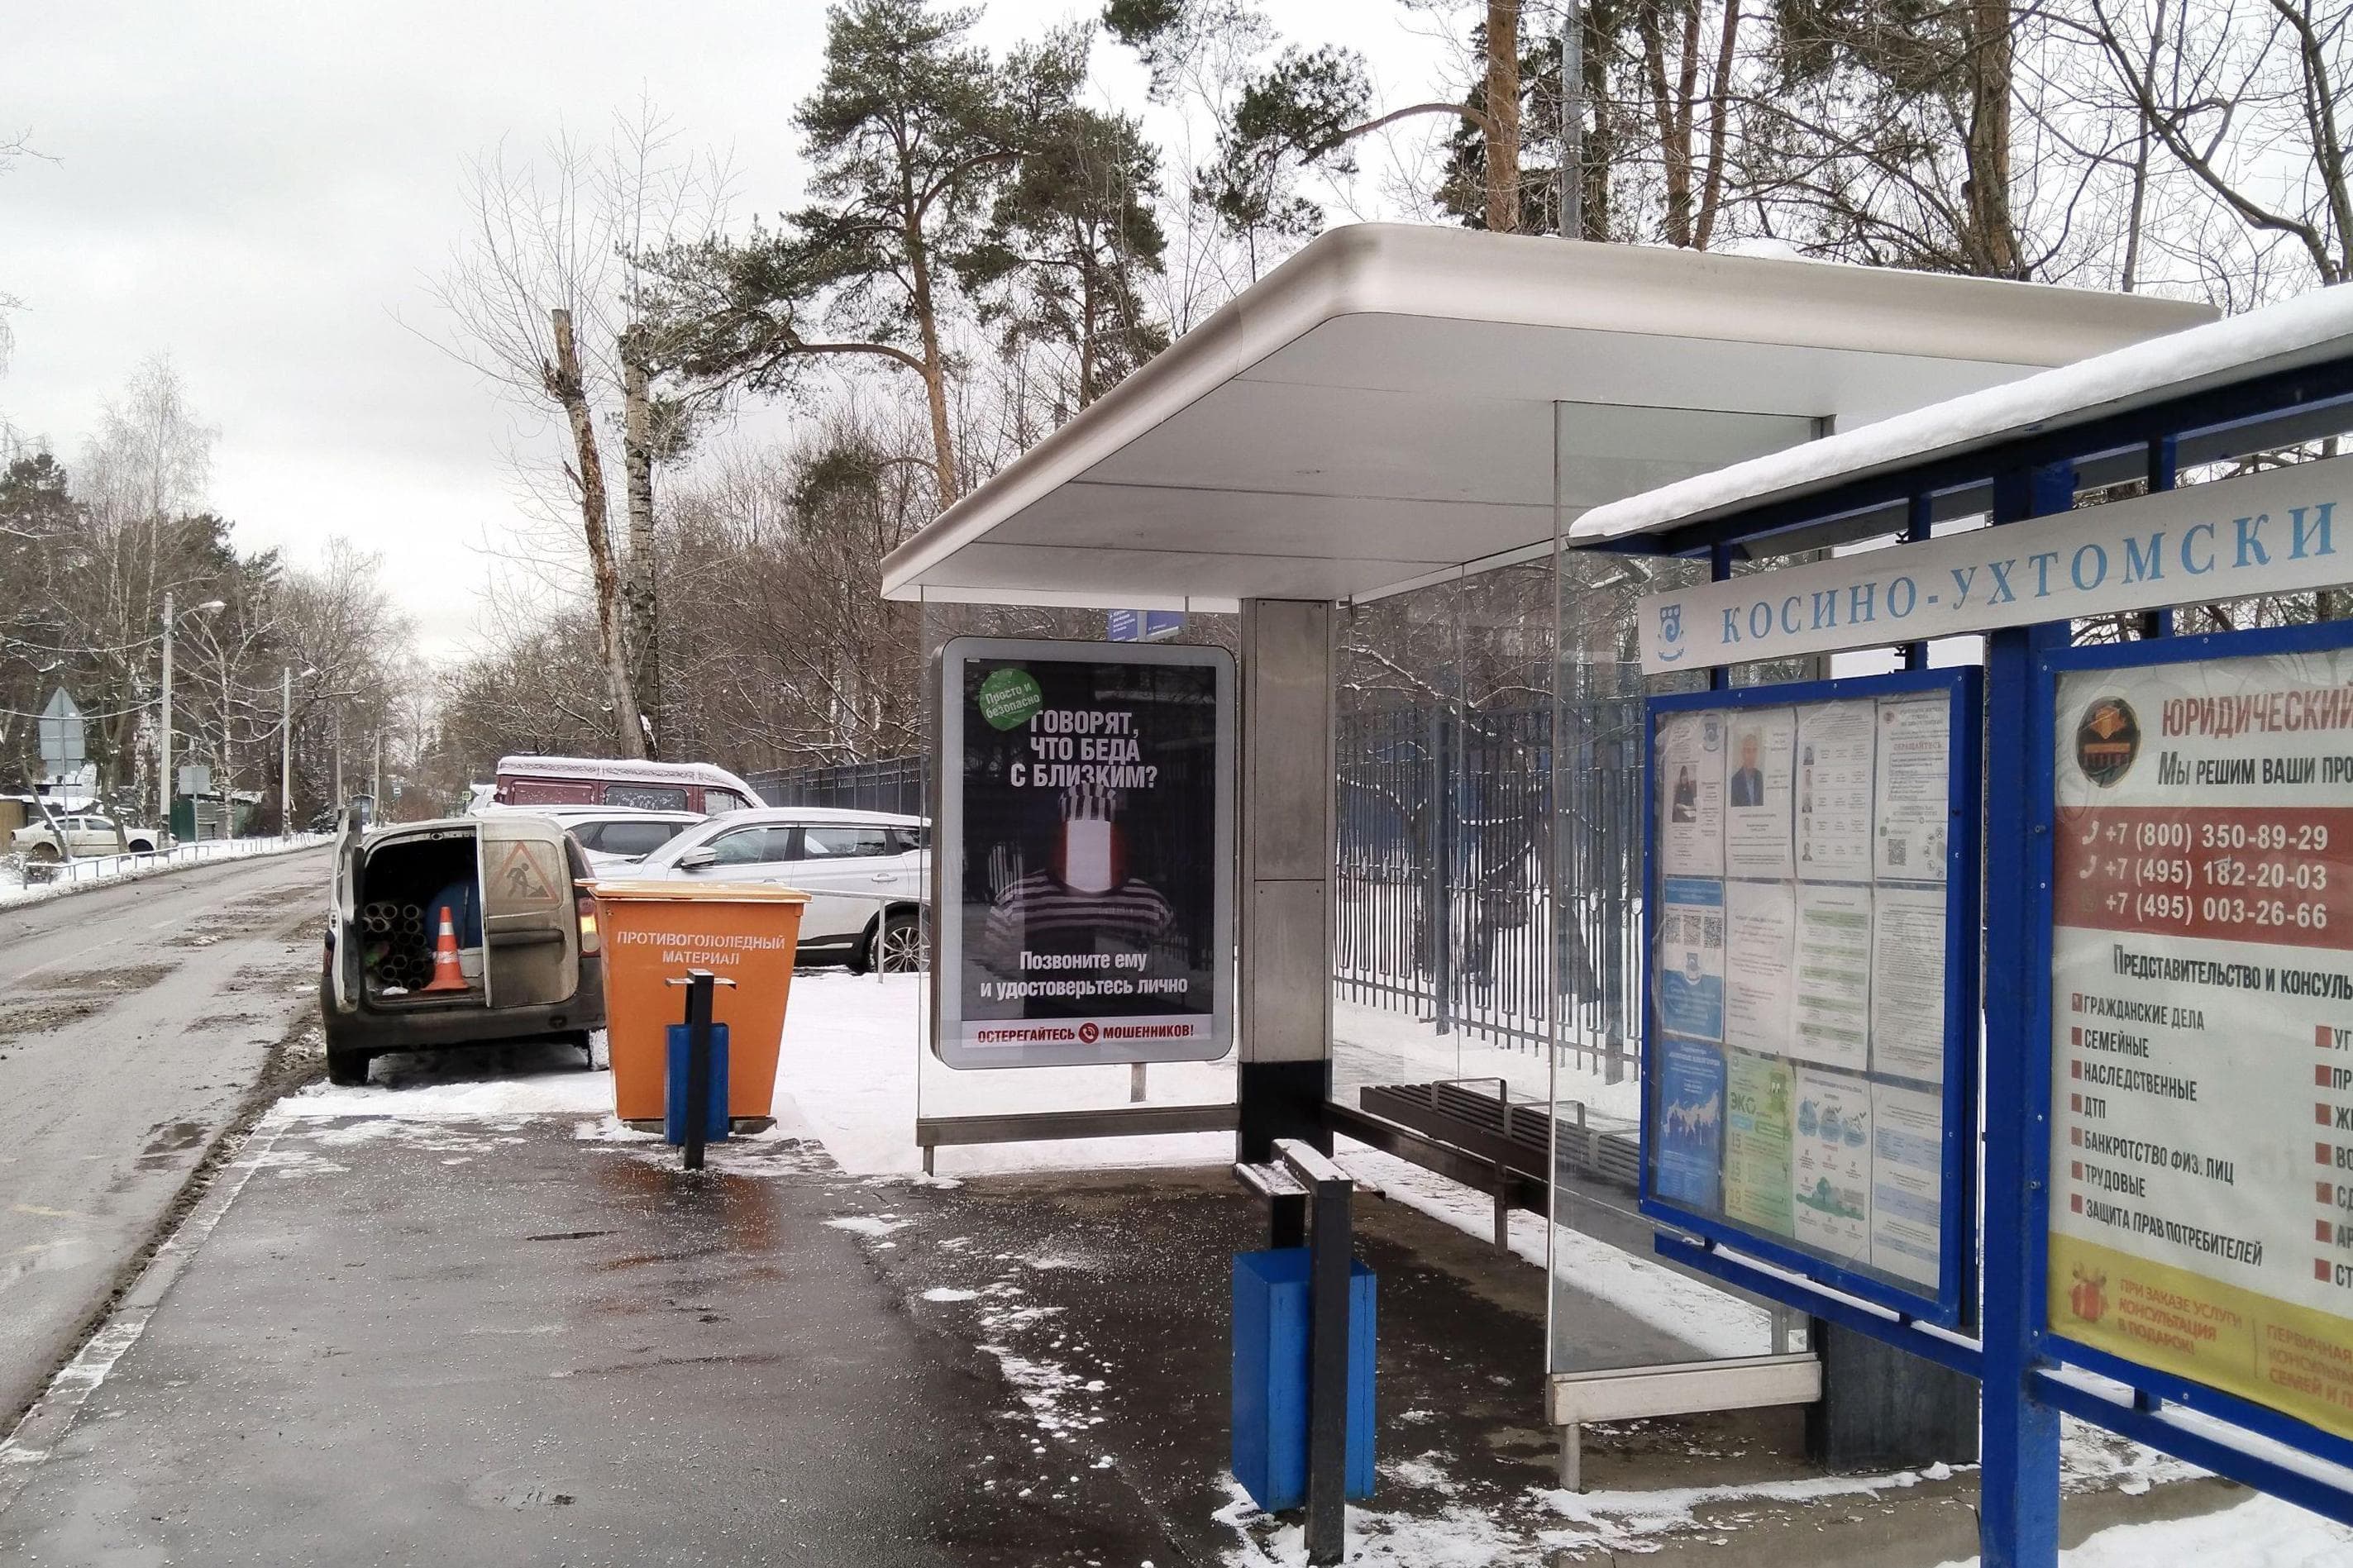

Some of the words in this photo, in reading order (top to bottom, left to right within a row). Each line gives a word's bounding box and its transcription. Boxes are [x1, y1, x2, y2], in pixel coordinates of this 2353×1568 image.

[986, 686, 1022, 704] Просто
[1024, 683, 1032, 692] и
[986, 694, 1040, 718] безопасно
[1031, 710, 1139, 737] ГОВОРЯТ,
[1030, 737, 1073, 760] ЧТО
[1081, 737, 1140, 765] БЕДА
[1010, 763, 1026, 787] С
[1033, 764, 1157, 788] БЛИЗКИМ?
[2196, 758, 2255, 785] РЕШИМ
[2263, 757, 2315, 784] ВАШИ
[2106, 823, 2128, 845] +7
[2136, 822, 2193, 853] (800)
[2202, 823, 2328, 851] 350-89-29
[2105, 858, 2128, 879] +7
[2136, 859, 2193, 890] (495)
[2203, 860, 2327, 891] 182-20-03
[2106, 892, 2128, 915] +7
[2136, 894, 2193, 926] (495)
[2203, 897, 2327, 929] 003-26-66
[618, 932, 785, 951] ПРОТИВОГОЛОЛЕДНЫЙ
[662, 951, 740, 965] МАТЕРИАЛ
[1019, 951, 1110, 970] Позвоните
[1114, 953, 1148, 971] ему
[981, 983, 992, 998] и
[996, 978, 1133, 1000] удостоверьтесь
[1137, 978, 1188, 995] лично
[2083, 994, 2168, 1025] ГРАЖДАНСКИЕ
[2171, 1007, 2205, 1030] ДЕЛА
[977, 1027, 1076, 1044] ОСТЕРЕГАЙТЕСЬ
[1103, 1024, 1194, 1040] МОШЕННИКОВ!
[2084, 1027, 2150, 1058] СЕМЕЙНЫЕ
[2084, 1061, 2198, 1101] НАСЛЕДСТВЕННЫЕ
[2084, 1096, 2107, 1119] ДТП
[2336, 1106, 2353, 1132] Ж
[2084, 1130, 2168, 1167] БАНКРОТСТВО
[2171, 1150, 2203, 1175] ФИЗ.
[2206, 1158, 2234, 1185] ЛИЦ
[2085, 1163, 2146, 1198] ТРУДОВЫЕ
[2086, 1199, 2131, 1231] ЗАЩИТА
[2132, 1212, 2164, 1237] ПРАВ
[2166, 1222, 2263, 1267] ПОТРЕБИТЕЛЕЙ
[2119, 1279, 2144, 1298] ПРИ
[2145, 1286, 2190, 1313] ЗАКАЗЕ
[2119, 1298, 2217, 1342] КОНСУЛЬТАЦИЯ
